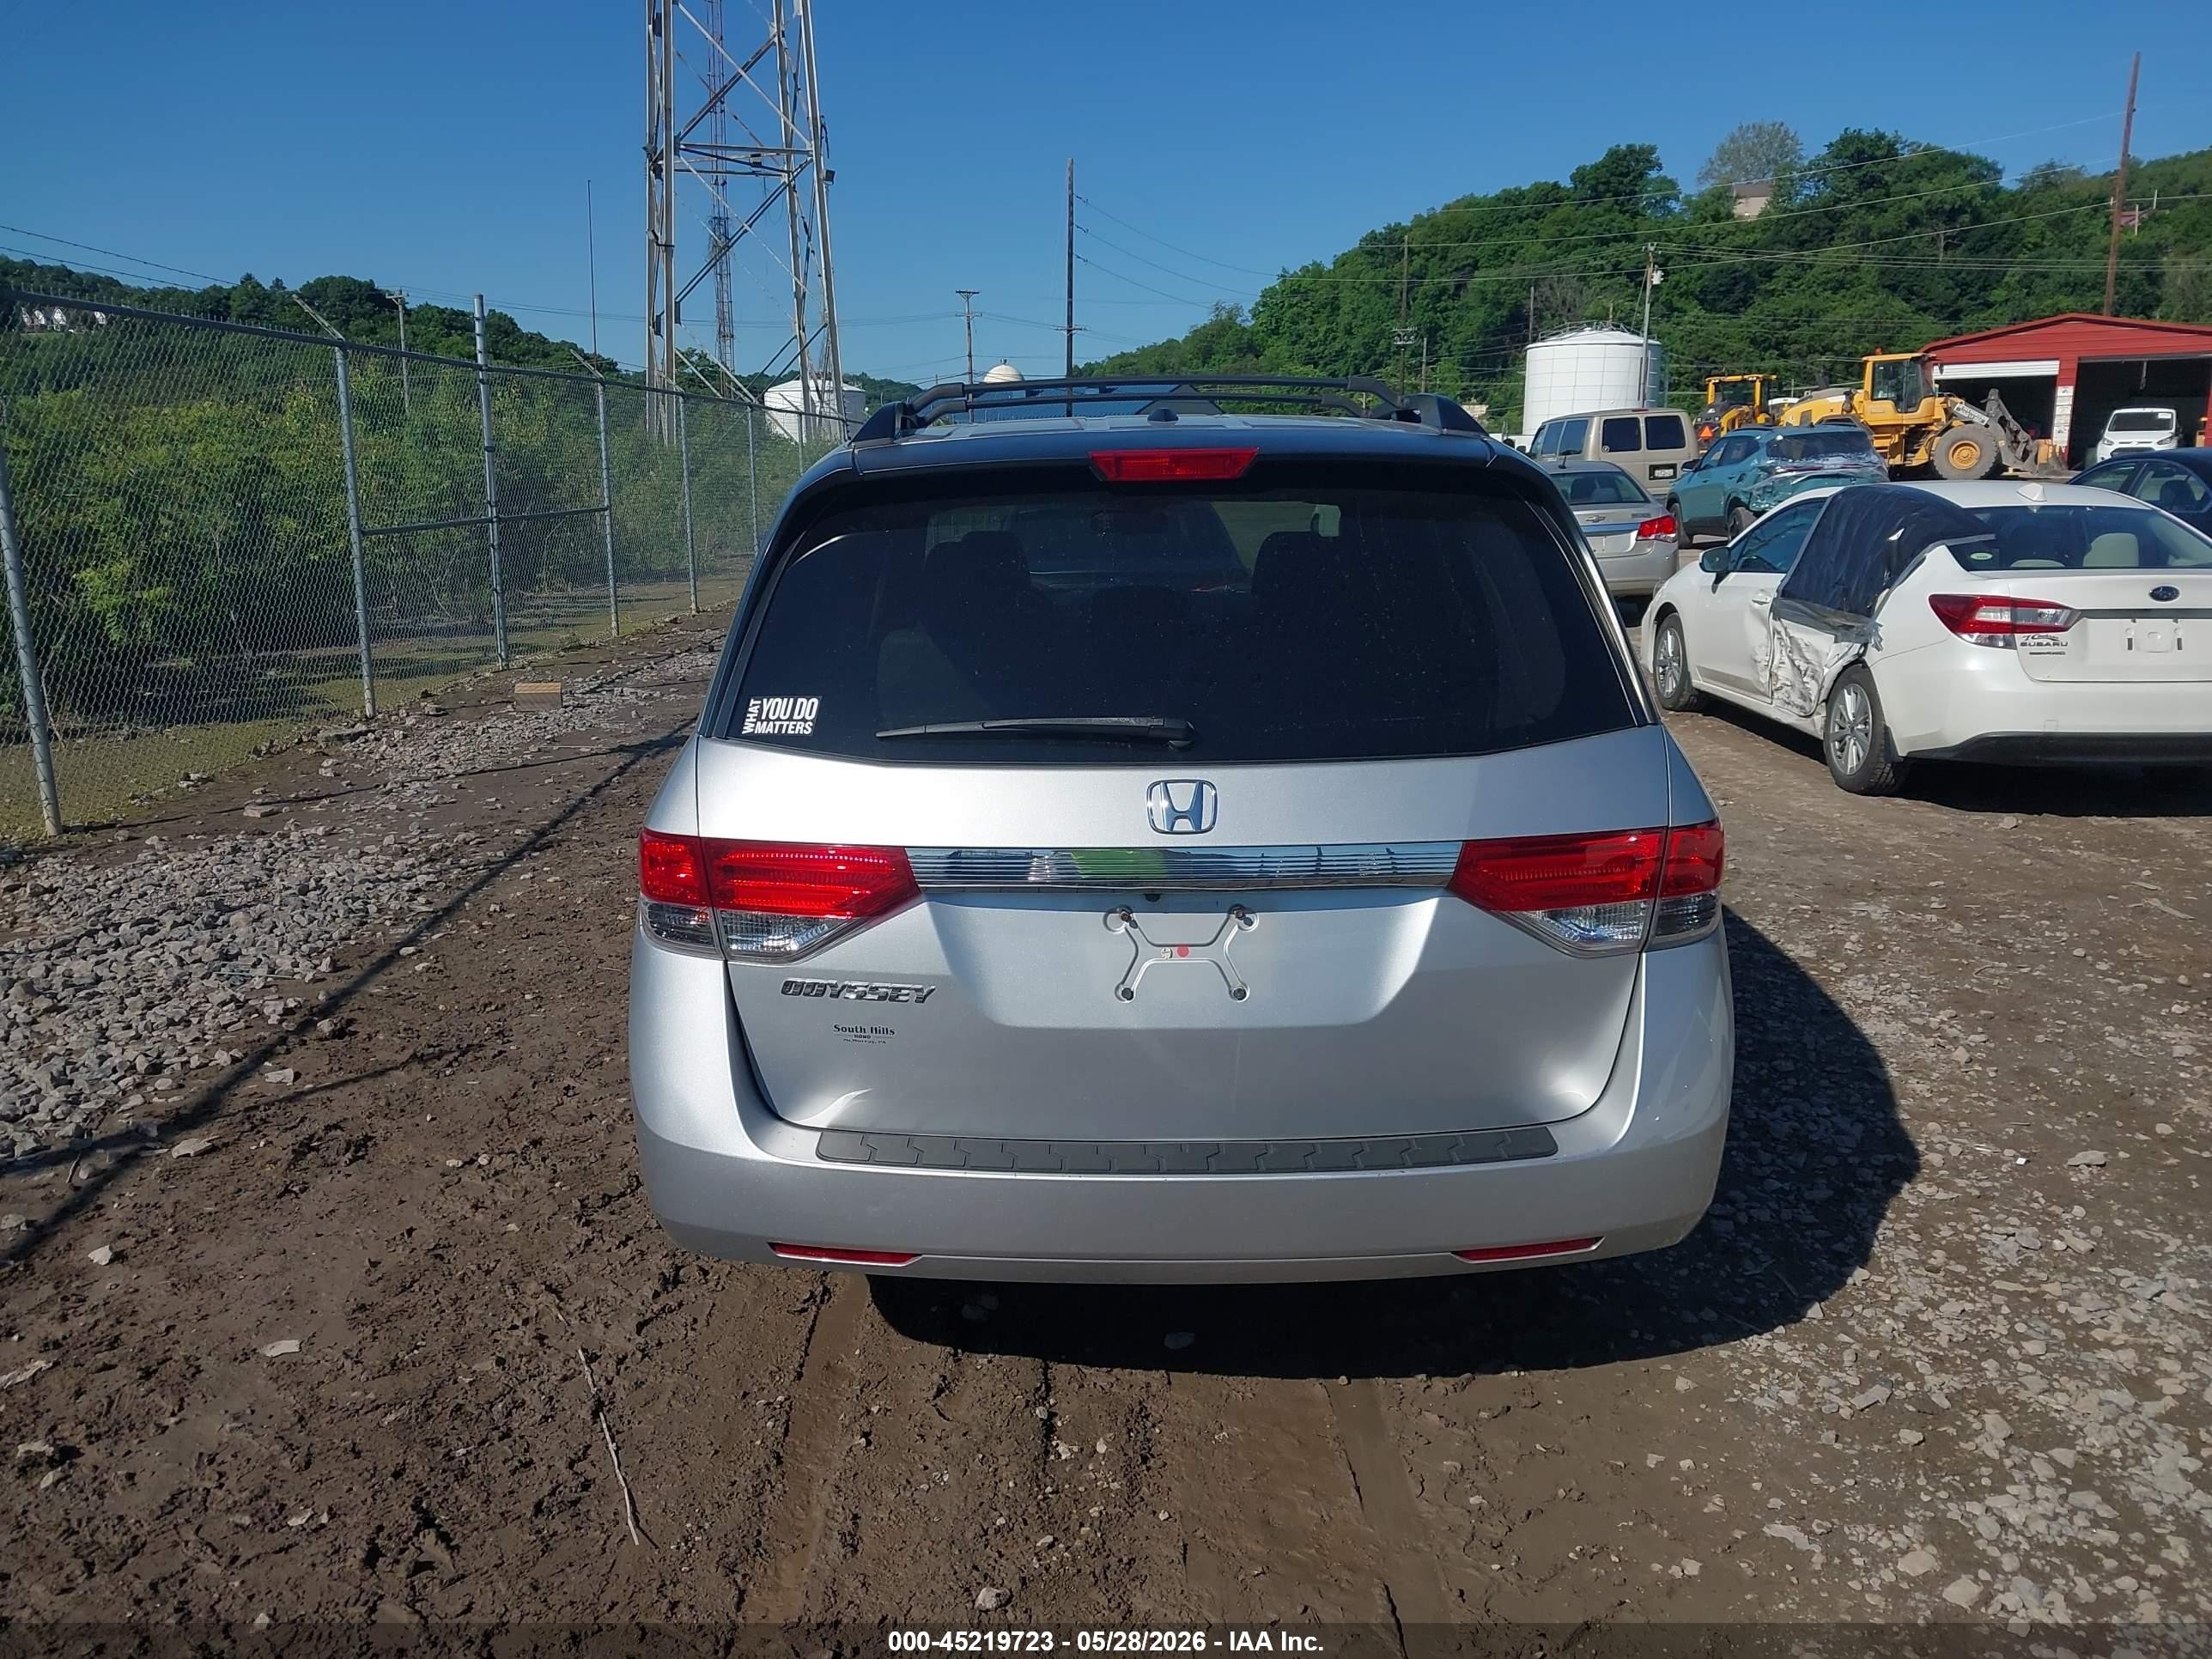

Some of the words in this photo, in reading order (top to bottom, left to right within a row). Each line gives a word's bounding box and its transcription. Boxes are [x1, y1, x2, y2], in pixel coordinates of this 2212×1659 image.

[741, 698, 762, 734] WHAT
[761, 697, 793, 720] YOU
[793, 697, 819, 720] DO
[754, 720, 813, 734] MATTERS
[781, 977, 936, 1004] ODYSSEY
[833, 1024, 866, 1034] South
[870, 1026, 896, 1036] Hills
